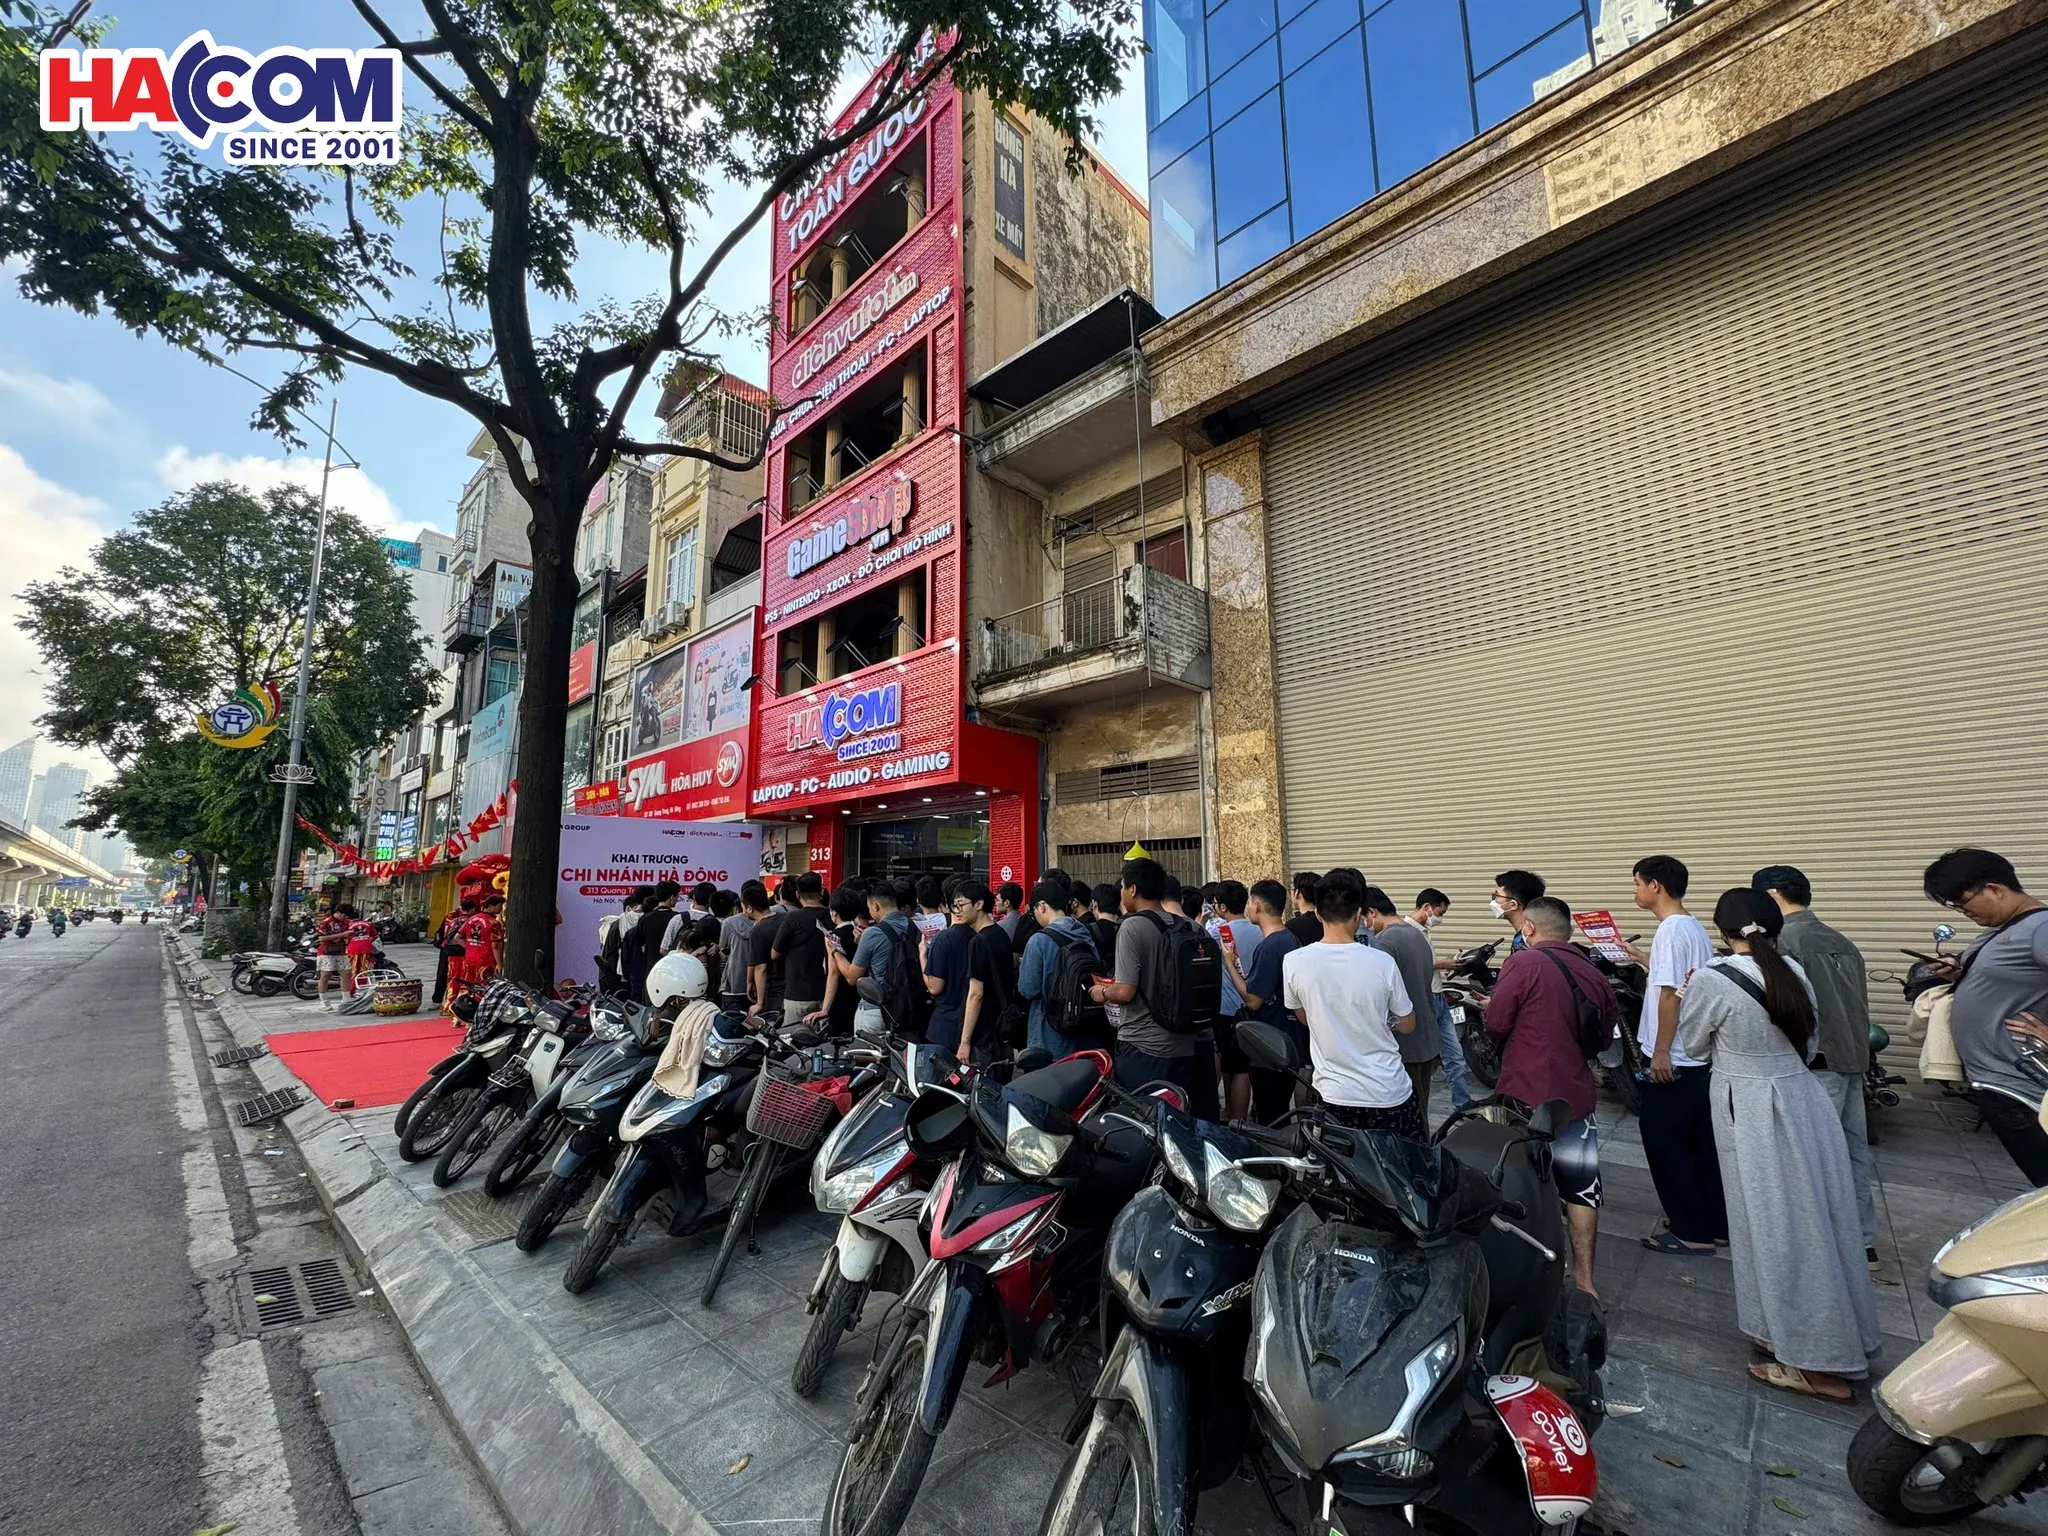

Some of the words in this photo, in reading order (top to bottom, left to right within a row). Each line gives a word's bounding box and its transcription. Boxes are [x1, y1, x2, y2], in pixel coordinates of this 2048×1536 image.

[1000, 154, 1017, 191] HÀ
[788, 174, 844, 251] TOÀN
[995, 211, 1006, 237] XE
[1006, 219, 1024, 250] MÁY
[838, 352, 870, 386] THOẠI
[878, 331, 896, 355] PC
[904, 285, 952, 332] LAPTOP
[764, 612, 778, 625] PS5
[782, 589, 821, 616] NINTENDO
[826, 572, 852, 594] XBOX
[858, 554, 874, 579] ĐỒ
[923, 522, 953, 546] HÌNH
[787, 683, 899, 750] HACOM
[838, 740, 869, 760] SINCE
[870, 735, 897, 753] 2001
[718, 754, 737, 776] SYM
[752, 783, 794, 804] LAPTOP
[800, 778, 820, 795] PC
[827, 767, 871, 790] AUDIO
[881, 751, 951, 780] GAMING
[624, 760, 668, 812] SYM
[670, 772, 692, 793] HÒA
[692, 768, 714, 789] HUY
[380, 812, 396, 825] SẢN
[564, 824, 591, 832] GROUP
[611, 853, 640, 864] KHAI
[641, 854, 689, 865] TRƯƠNG
[810, 847, 831, 861] 313
[560, 867, 592, 882] CHI
[596, 866, 655, 882] NHÁNH
[659, 866, 680, 882] HÀ
[683, 866, 729, 882] ĐÔNG
[586, 886, 599, 895] 313
[600, 886, 627, 896] Quang
[873, 1203, 901, 1218] HONDA
[1170, 1223, 1206, 1248] HONDA
[1333, 1248, 1377, 1265] HONDA
[1531, 1409, 1575, 1475] goviet
